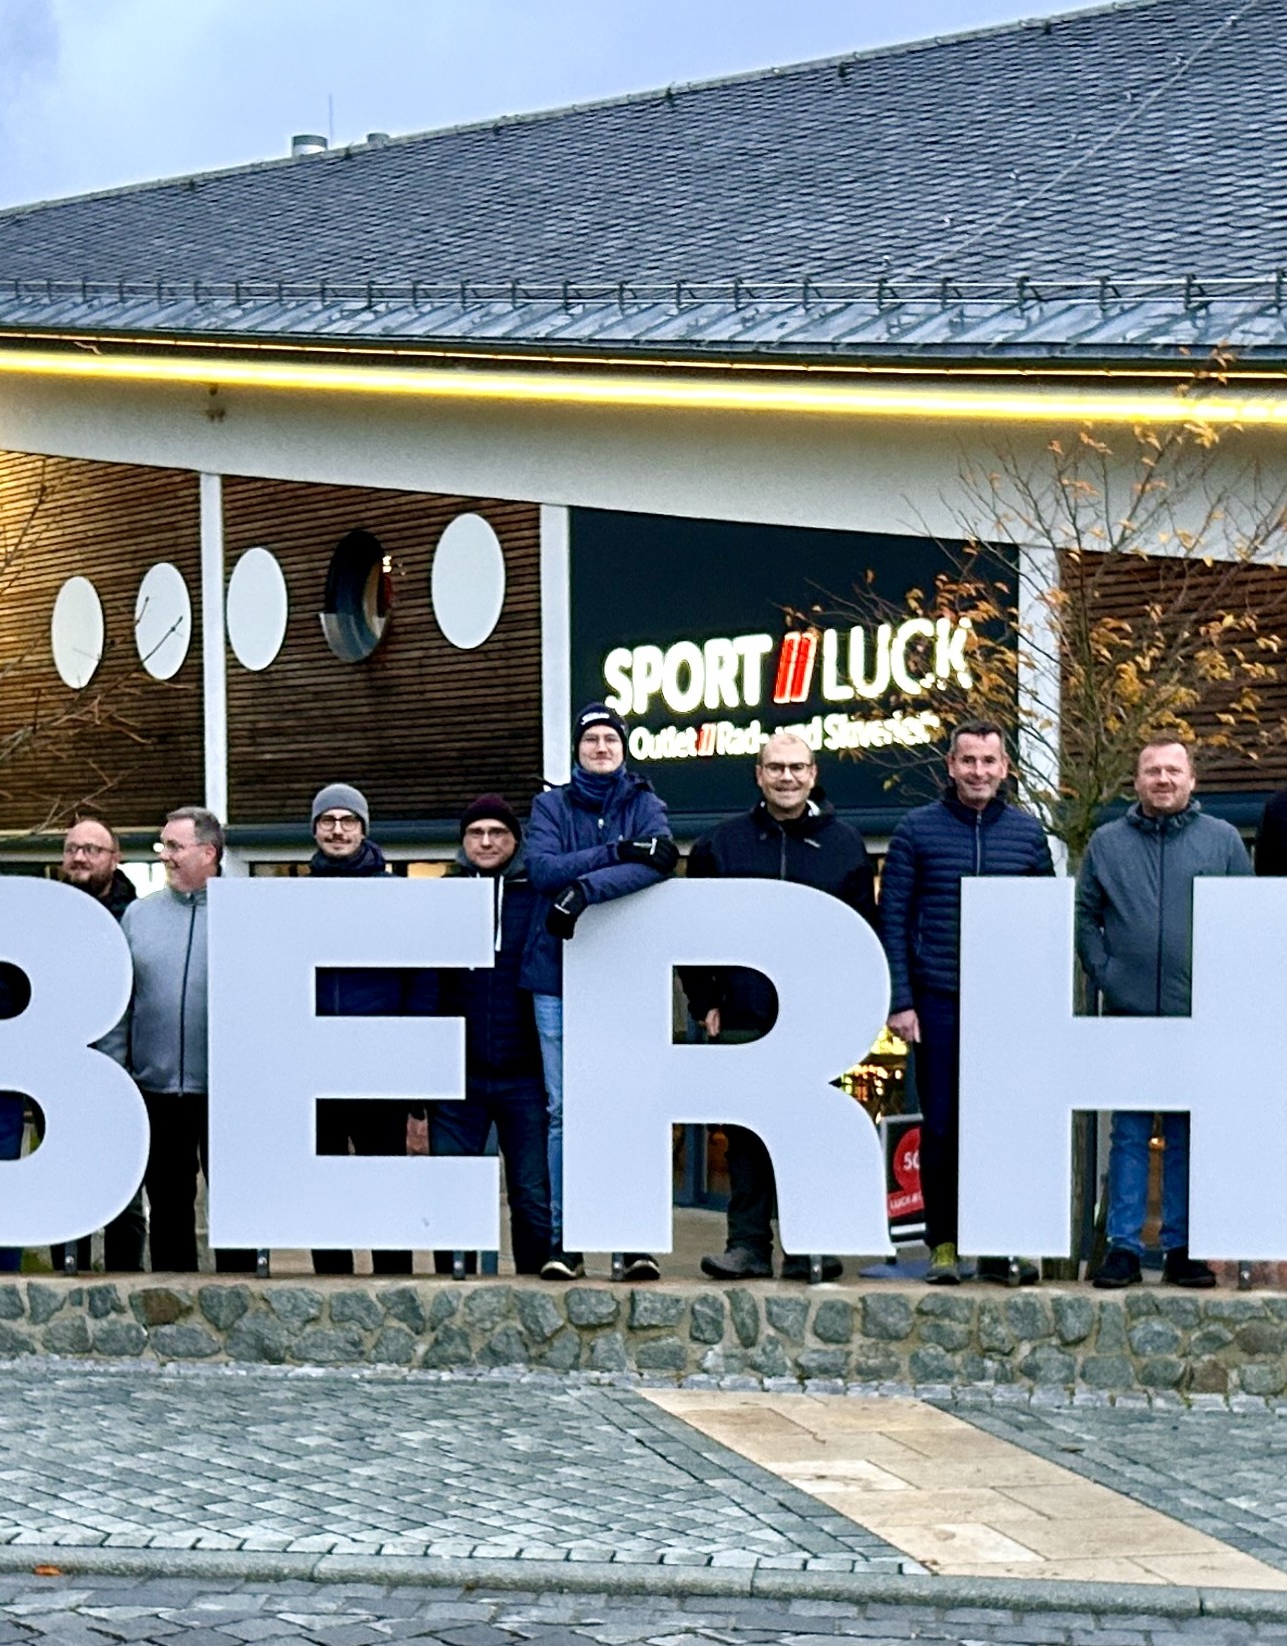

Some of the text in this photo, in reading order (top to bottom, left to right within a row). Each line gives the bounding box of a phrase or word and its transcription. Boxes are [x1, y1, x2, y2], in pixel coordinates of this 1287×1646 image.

[604, 633, 773, 716] SPORT
[823, 617, 973, 700] LUCK
[629, 725, 698, 760] Outlet
